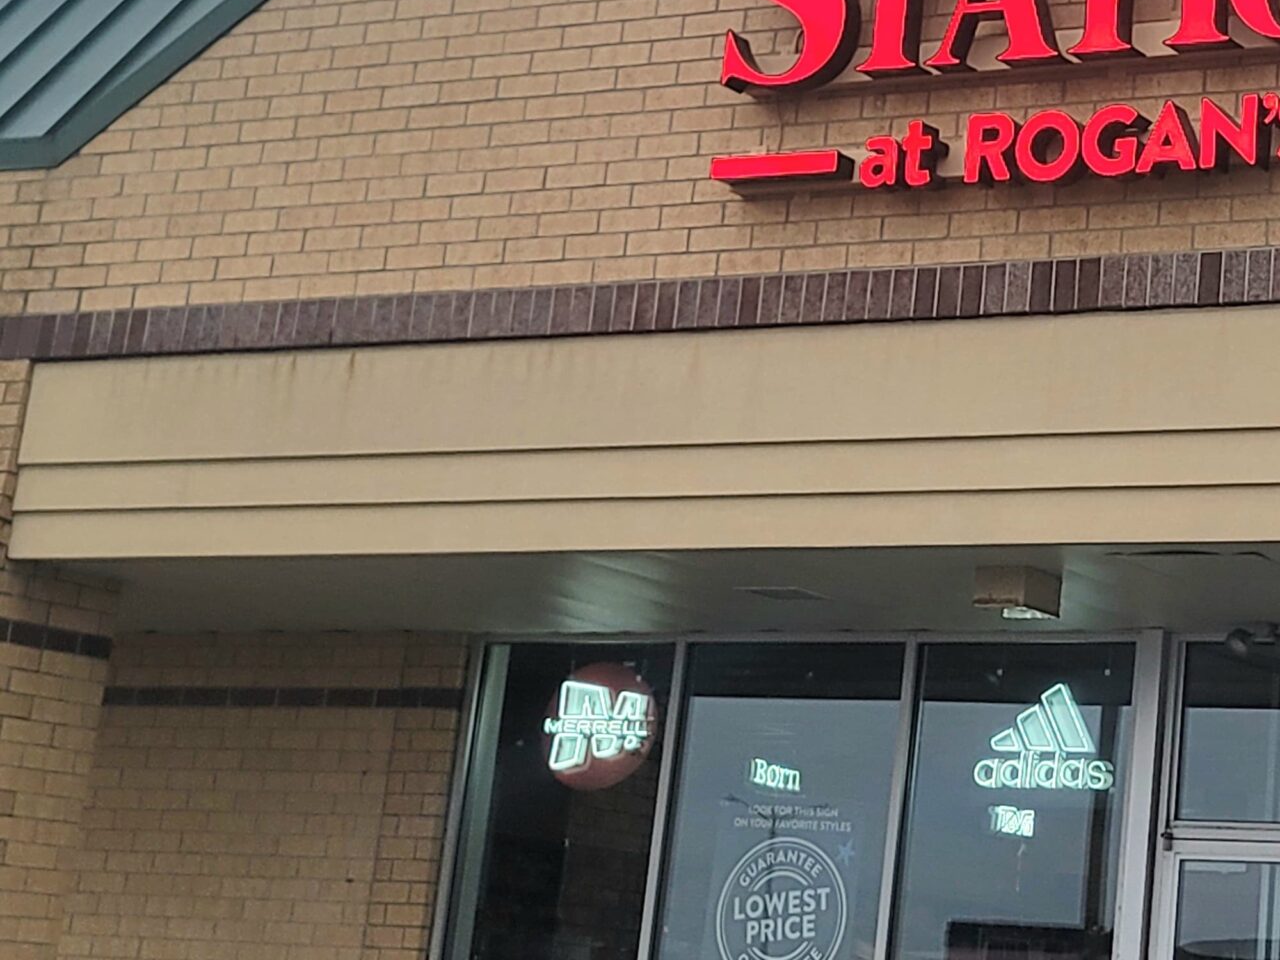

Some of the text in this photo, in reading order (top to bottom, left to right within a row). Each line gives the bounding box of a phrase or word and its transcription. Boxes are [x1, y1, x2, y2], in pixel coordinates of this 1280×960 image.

[859, 120, 940, 189] at
[543, 717, 649, 737] MERRELL
[973, 751, 1113, 789] adidas
[734, 817, 748, 827] ON
[820, 821, 851, 832] STYLES
[748, 804, 838, 818] LOOK FOR THIS SIGN
[739, 849, 823, 887] GUARANTEE
[733, 887, 830, 920] LOWEST
[746, 914, 816, 944] PRICE
